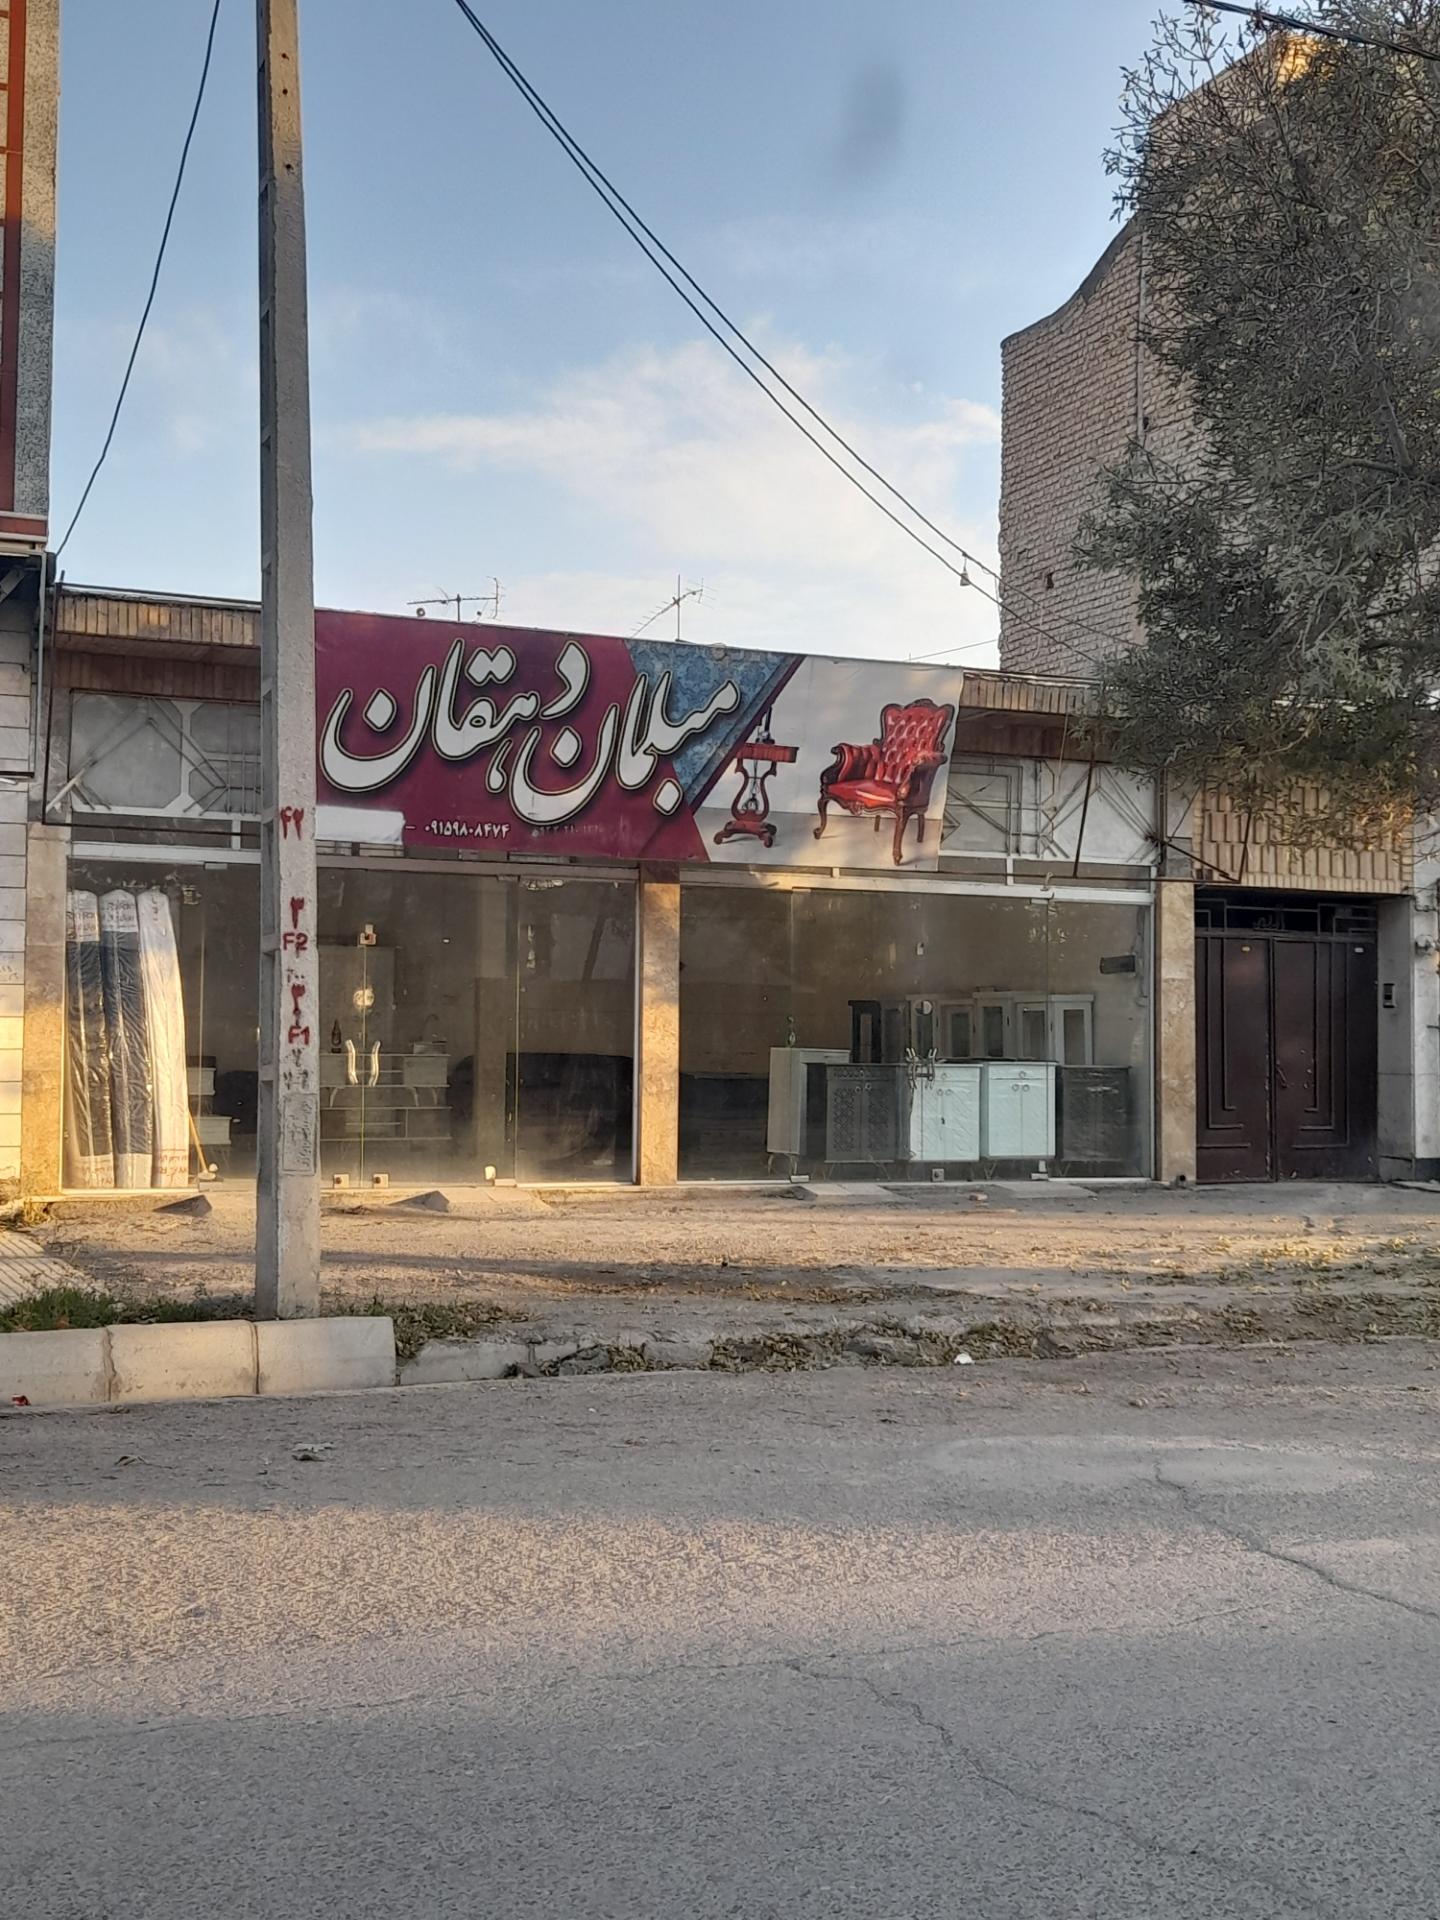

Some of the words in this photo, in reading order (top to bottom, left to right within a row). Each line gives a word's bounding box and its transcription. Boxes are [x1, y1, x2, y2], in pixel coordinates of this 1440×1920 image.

[320, 638, 590, 793] دهقان
[509, 671, 741, 825] مبلمان
[424, 819, 511, 839] ۰۹۱۵۹۸۰۸۴۷۴
[283, 932, 308, 951] F2
[288, 1025, 310, 1046] F1
